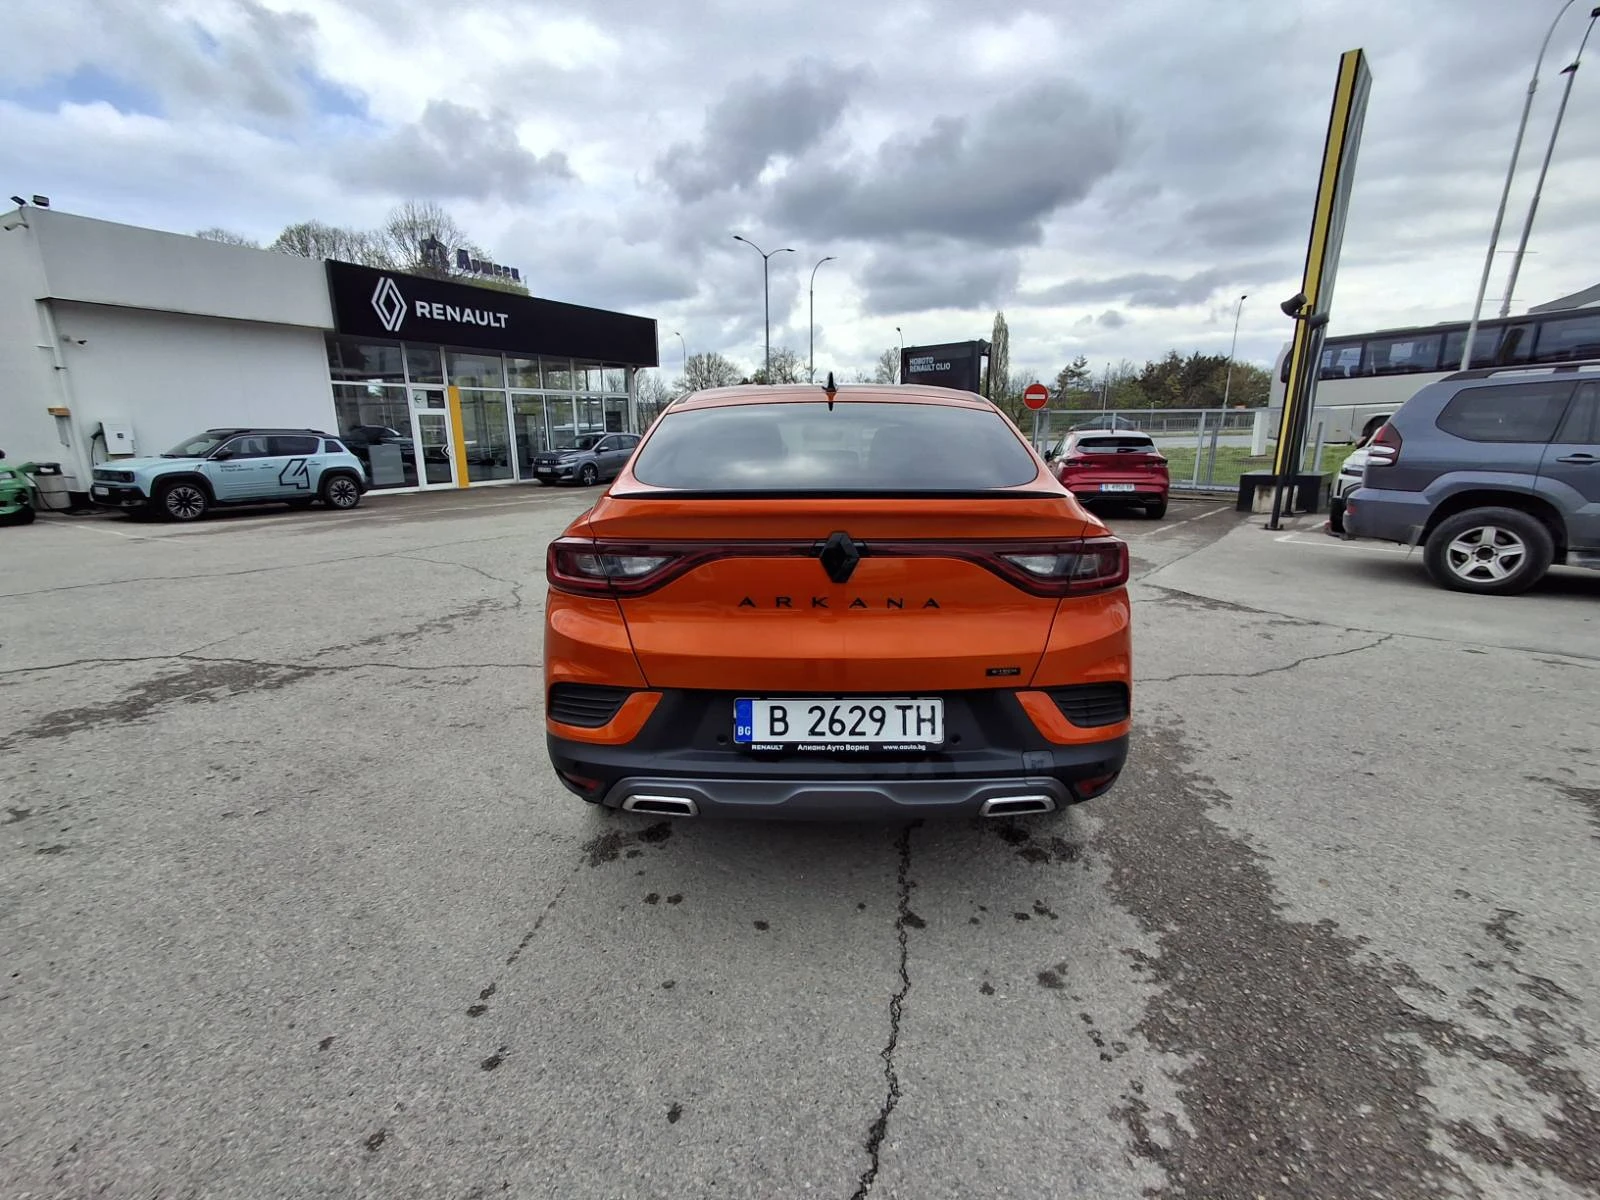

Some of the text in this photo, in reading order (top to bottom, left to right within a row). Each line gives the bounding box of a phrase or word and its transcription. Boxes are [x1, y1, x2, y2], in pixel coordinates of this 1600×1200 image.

[415, 300, 509, 329] RENAULT
[909, 362, 950, 372] RENAULT CLIO
[737, 596, 941, 609] ARKANA
[807, 705, 887, 737] 2629
[737, 726, 751, 736] BG
[826, 744, 845, 752] Ауто
